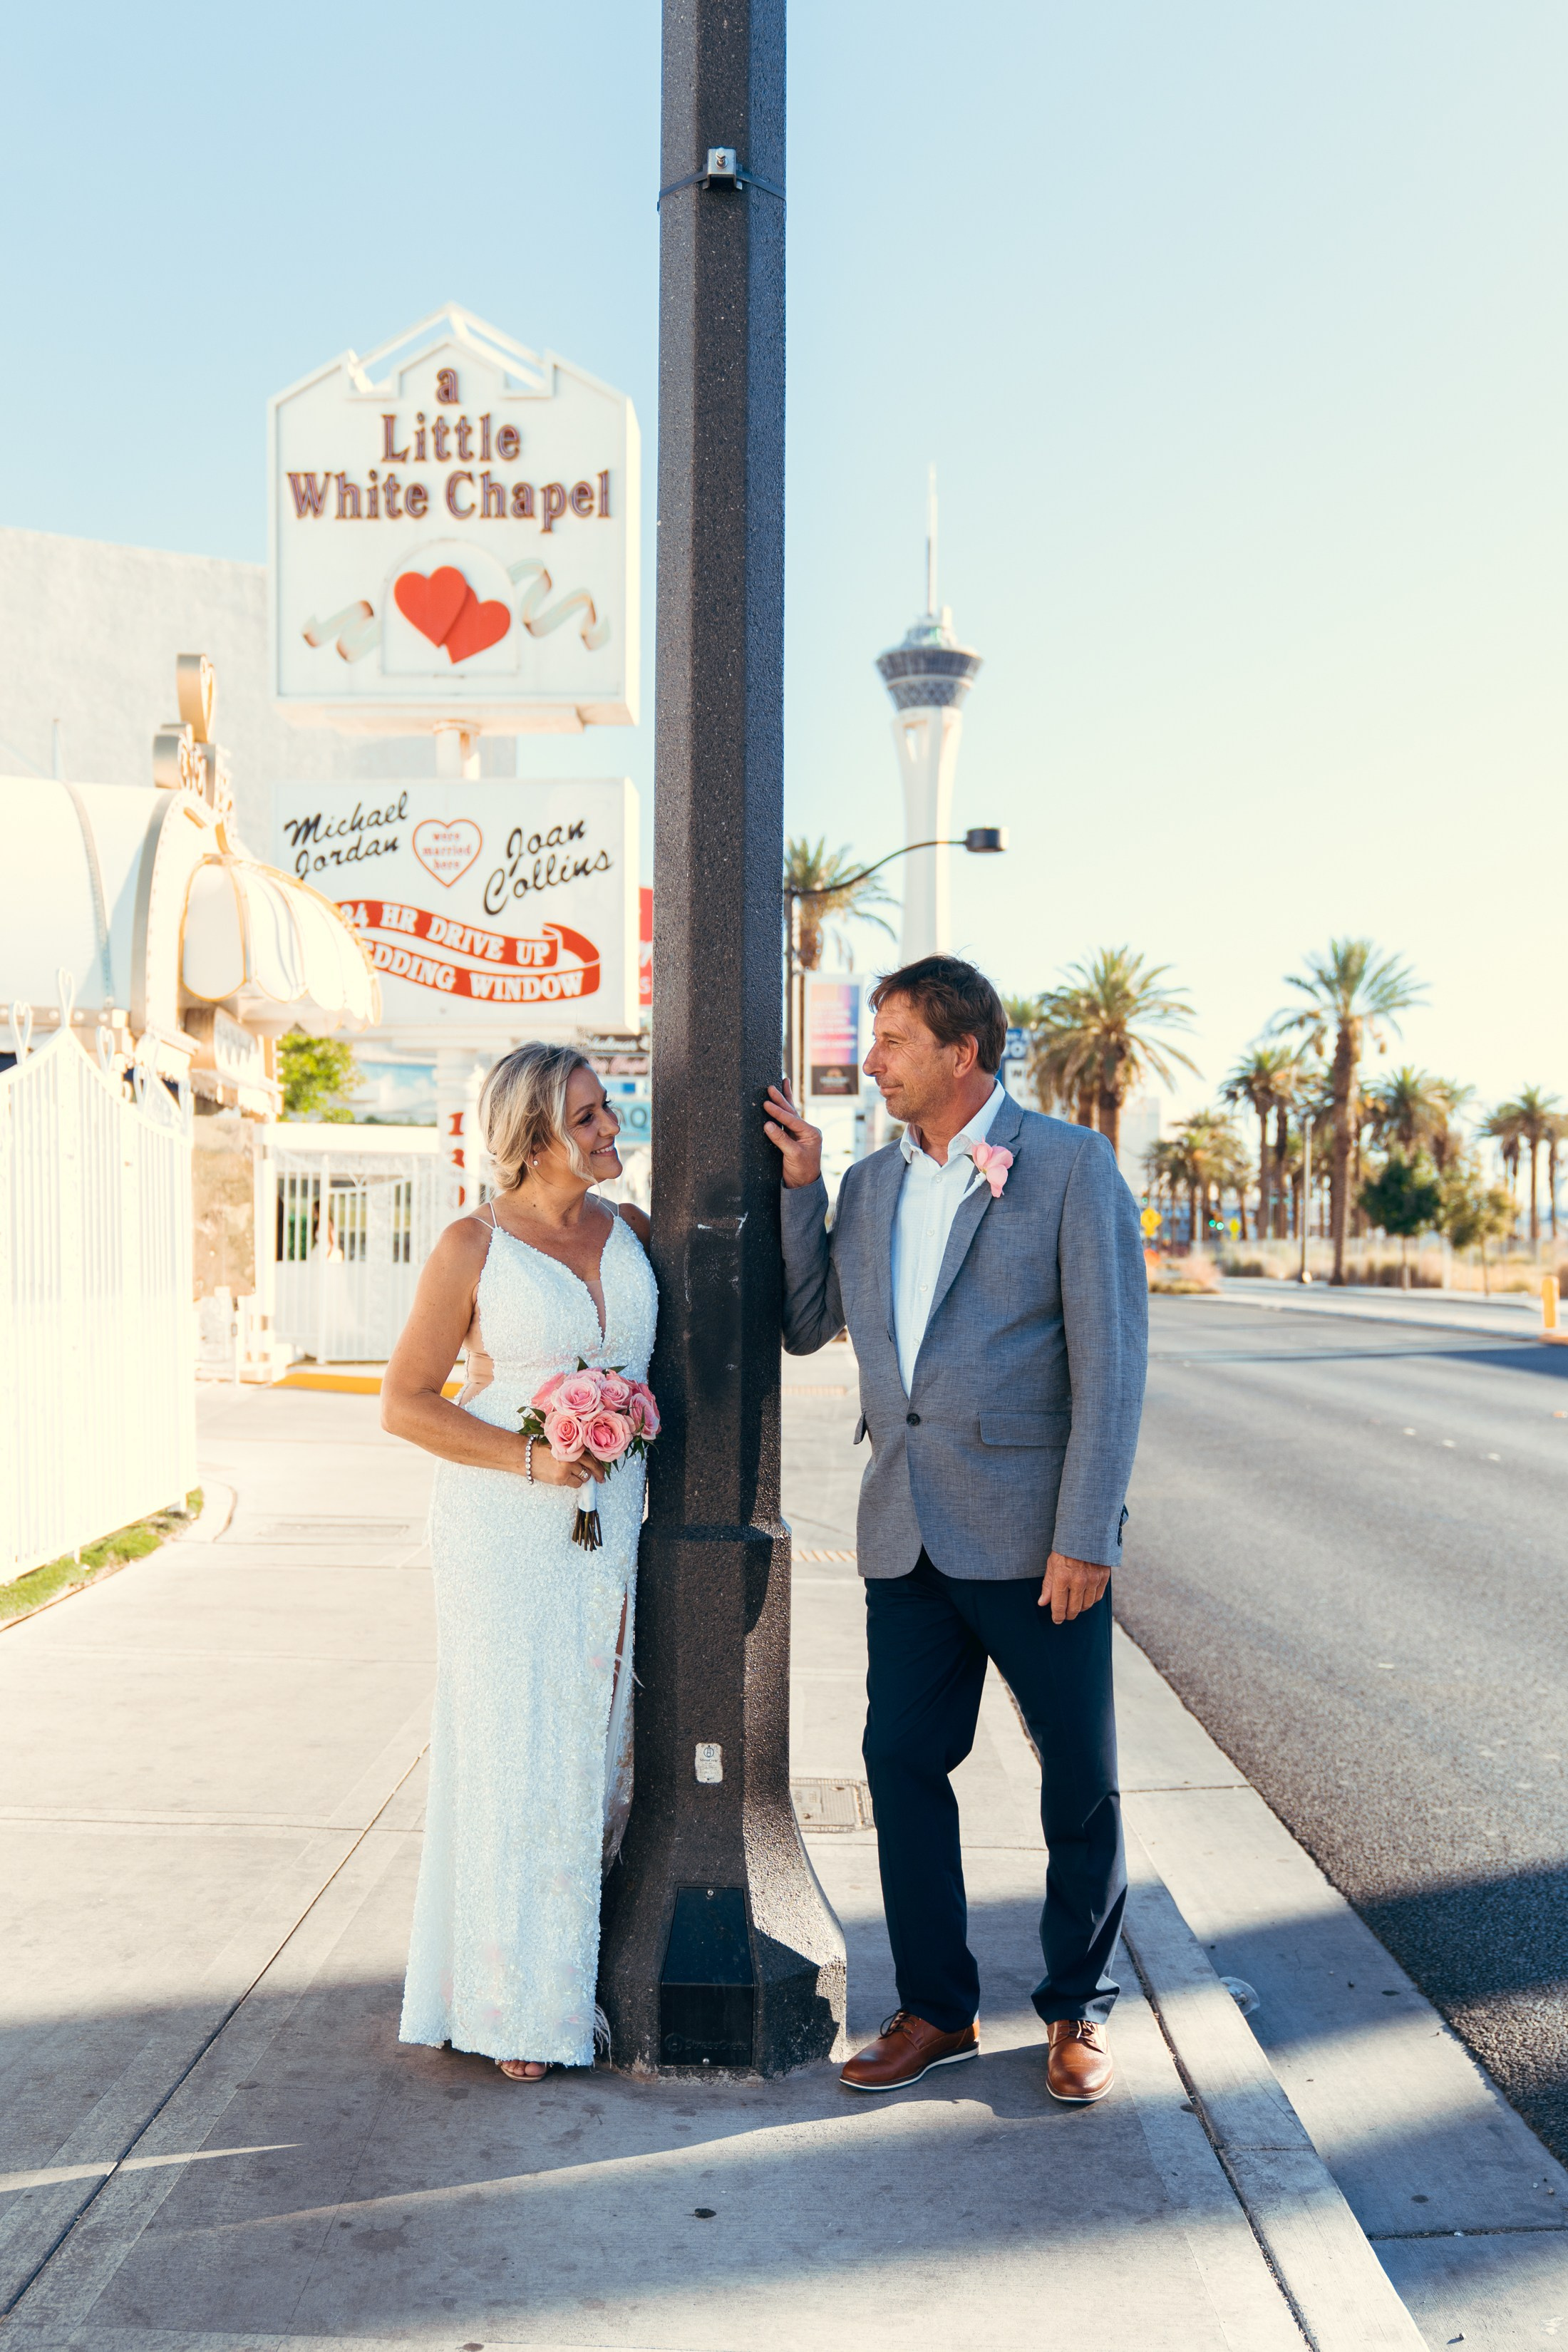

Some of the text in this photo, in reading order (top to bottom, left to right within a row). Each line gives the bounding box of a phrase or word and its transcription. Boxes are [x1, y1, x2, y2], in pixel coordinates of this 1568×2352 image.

[435, 368, 460, 405] a
[381, 411, 520, 464] Little
[287, 468, 611, 534] White Chapel
[284, 790, 408, 846] Michael
[296, 835, 398, 881] Jordan
[423, 843, 471, 855] married
[433, 858, 460, 869] here
[506, 820, 586, 877] Joan
[483, 850, 614, 916] Collins
[341, 902, 550, 966] 24 HR DRIVE UP
[469, 970, 584, 1001] WINDOW
